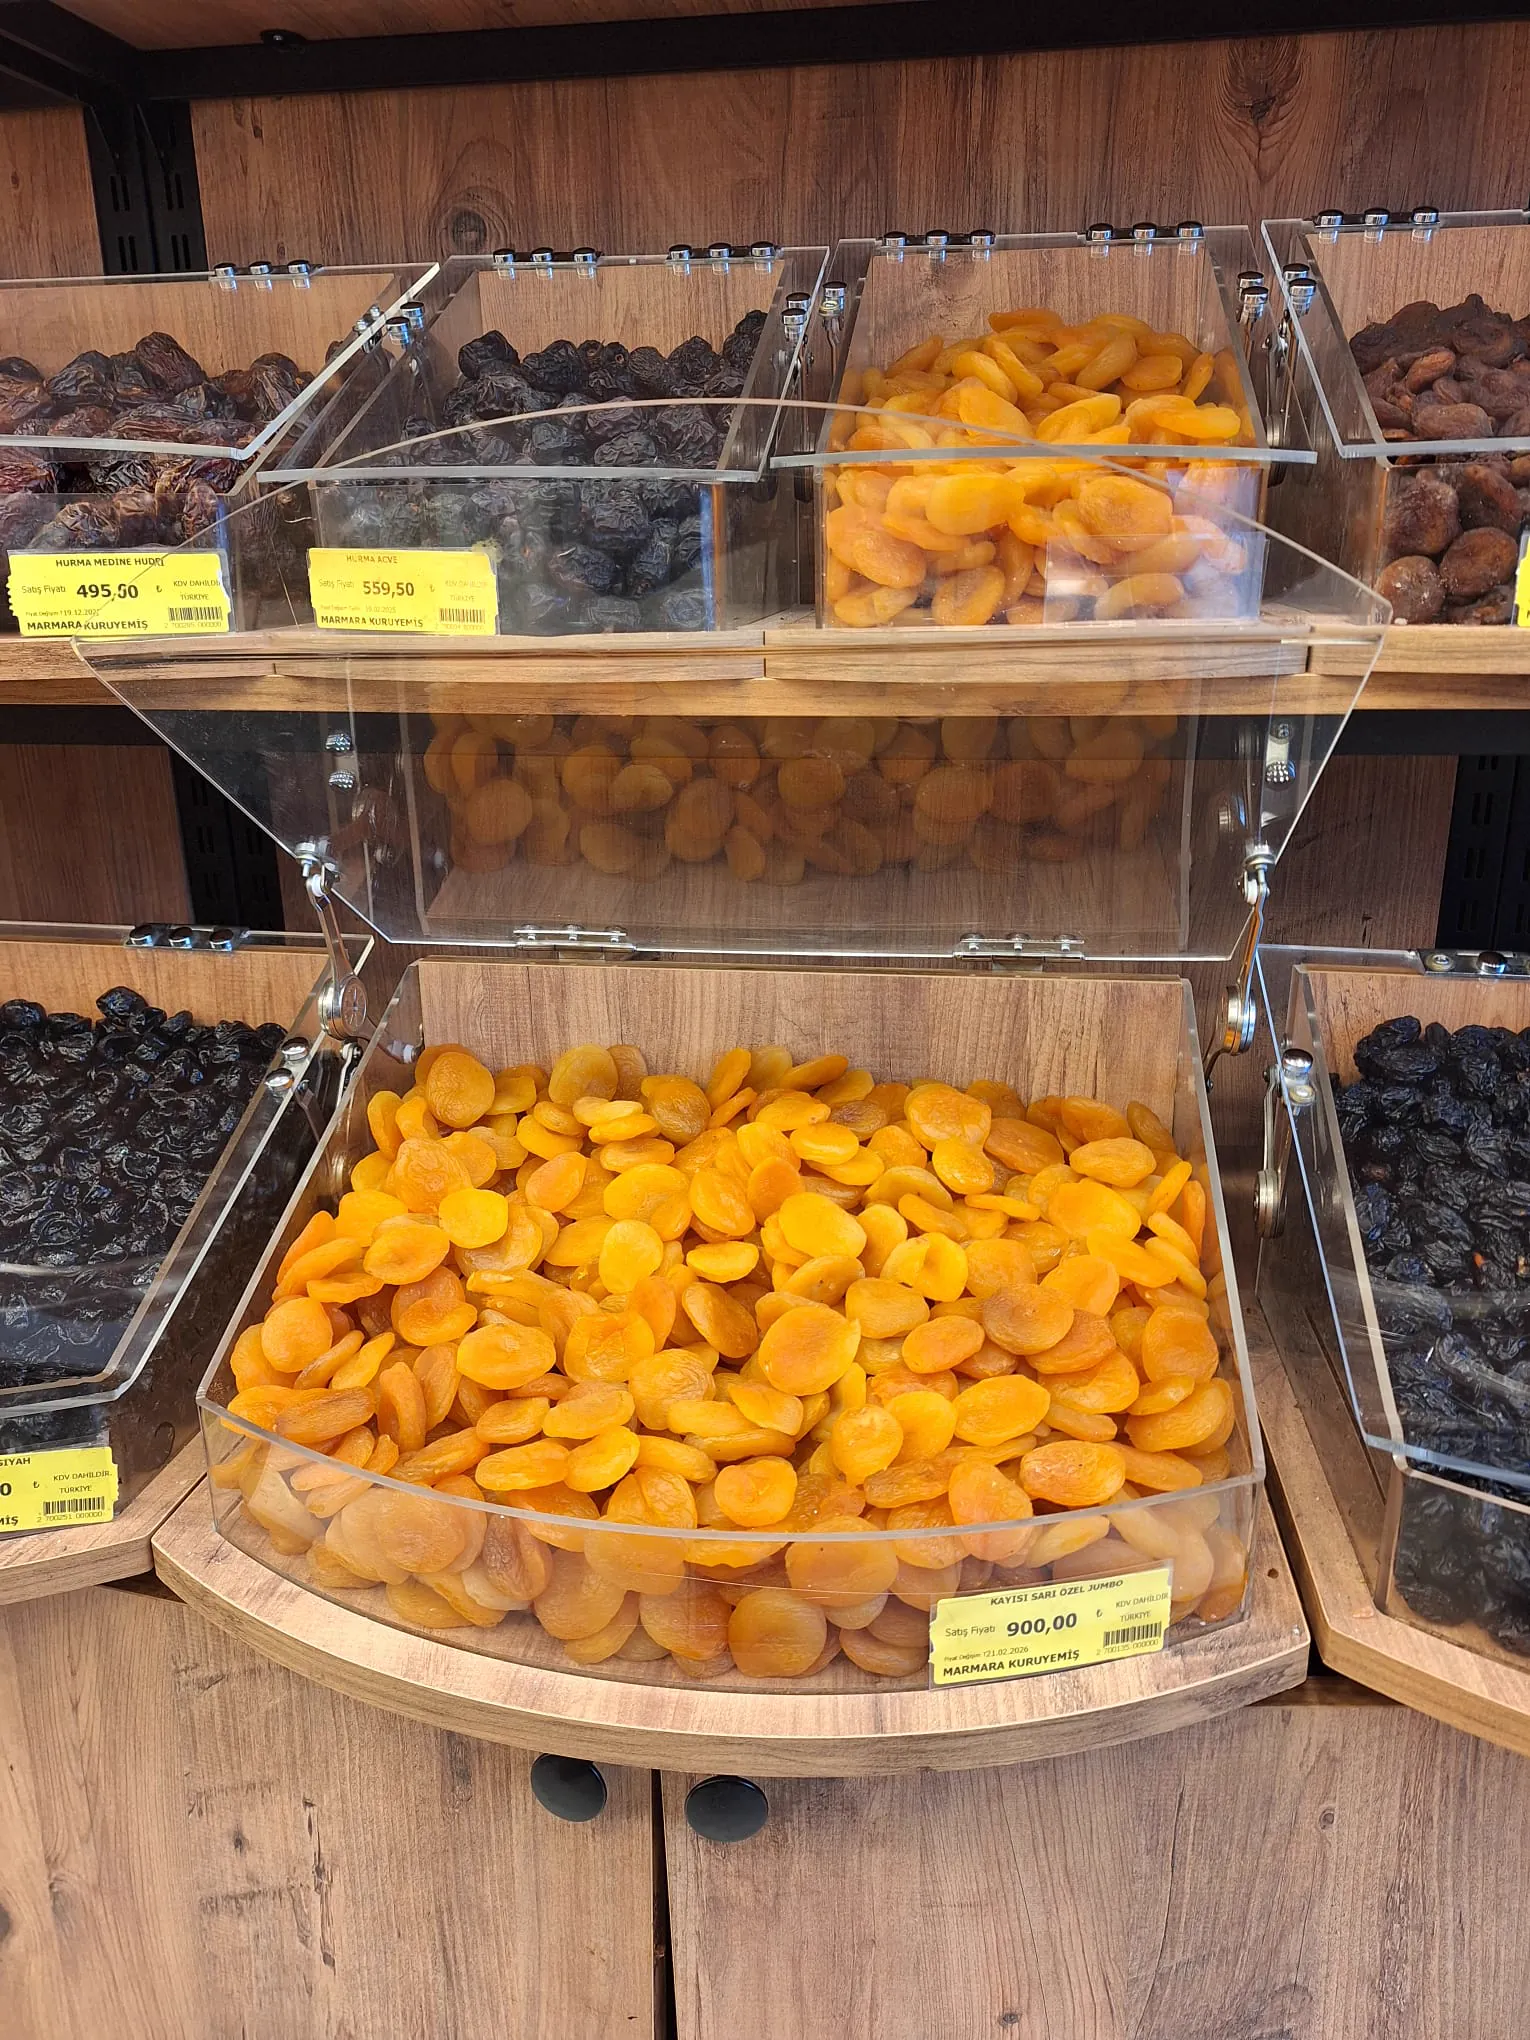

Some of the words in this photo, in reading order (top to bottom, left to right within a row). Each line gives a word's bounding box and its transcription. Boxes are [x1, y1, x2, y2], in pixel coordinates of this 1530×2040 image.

[55, 559, 92, 567] HURMA
[21, 585, 42, 595] Satış
[44, 584, 67, 594] Fiyatı
[362, 581, 415, 598] 559,50
[27, 621, 82, 630] MARMARA
[321, 616, 368, 625] MARMARA
[990, 1594, 1028, 1606] KAYISI
[1031, 1590, 1057, 1601] SARI
[1088, 1580, 1124, 1592] JUMBO
[1115, 1600, 1131, 1608] KDV
[945, 1627, 968, 1637] Satış
[970, 1625, 996, 1635] Fiyatı
[1006, 1612, 1077, 1637] 900,00
[943, 1661, 1005, 1677] MARMARA
[1008, 1649, 1080, 1669] KURUYEMİŞ
